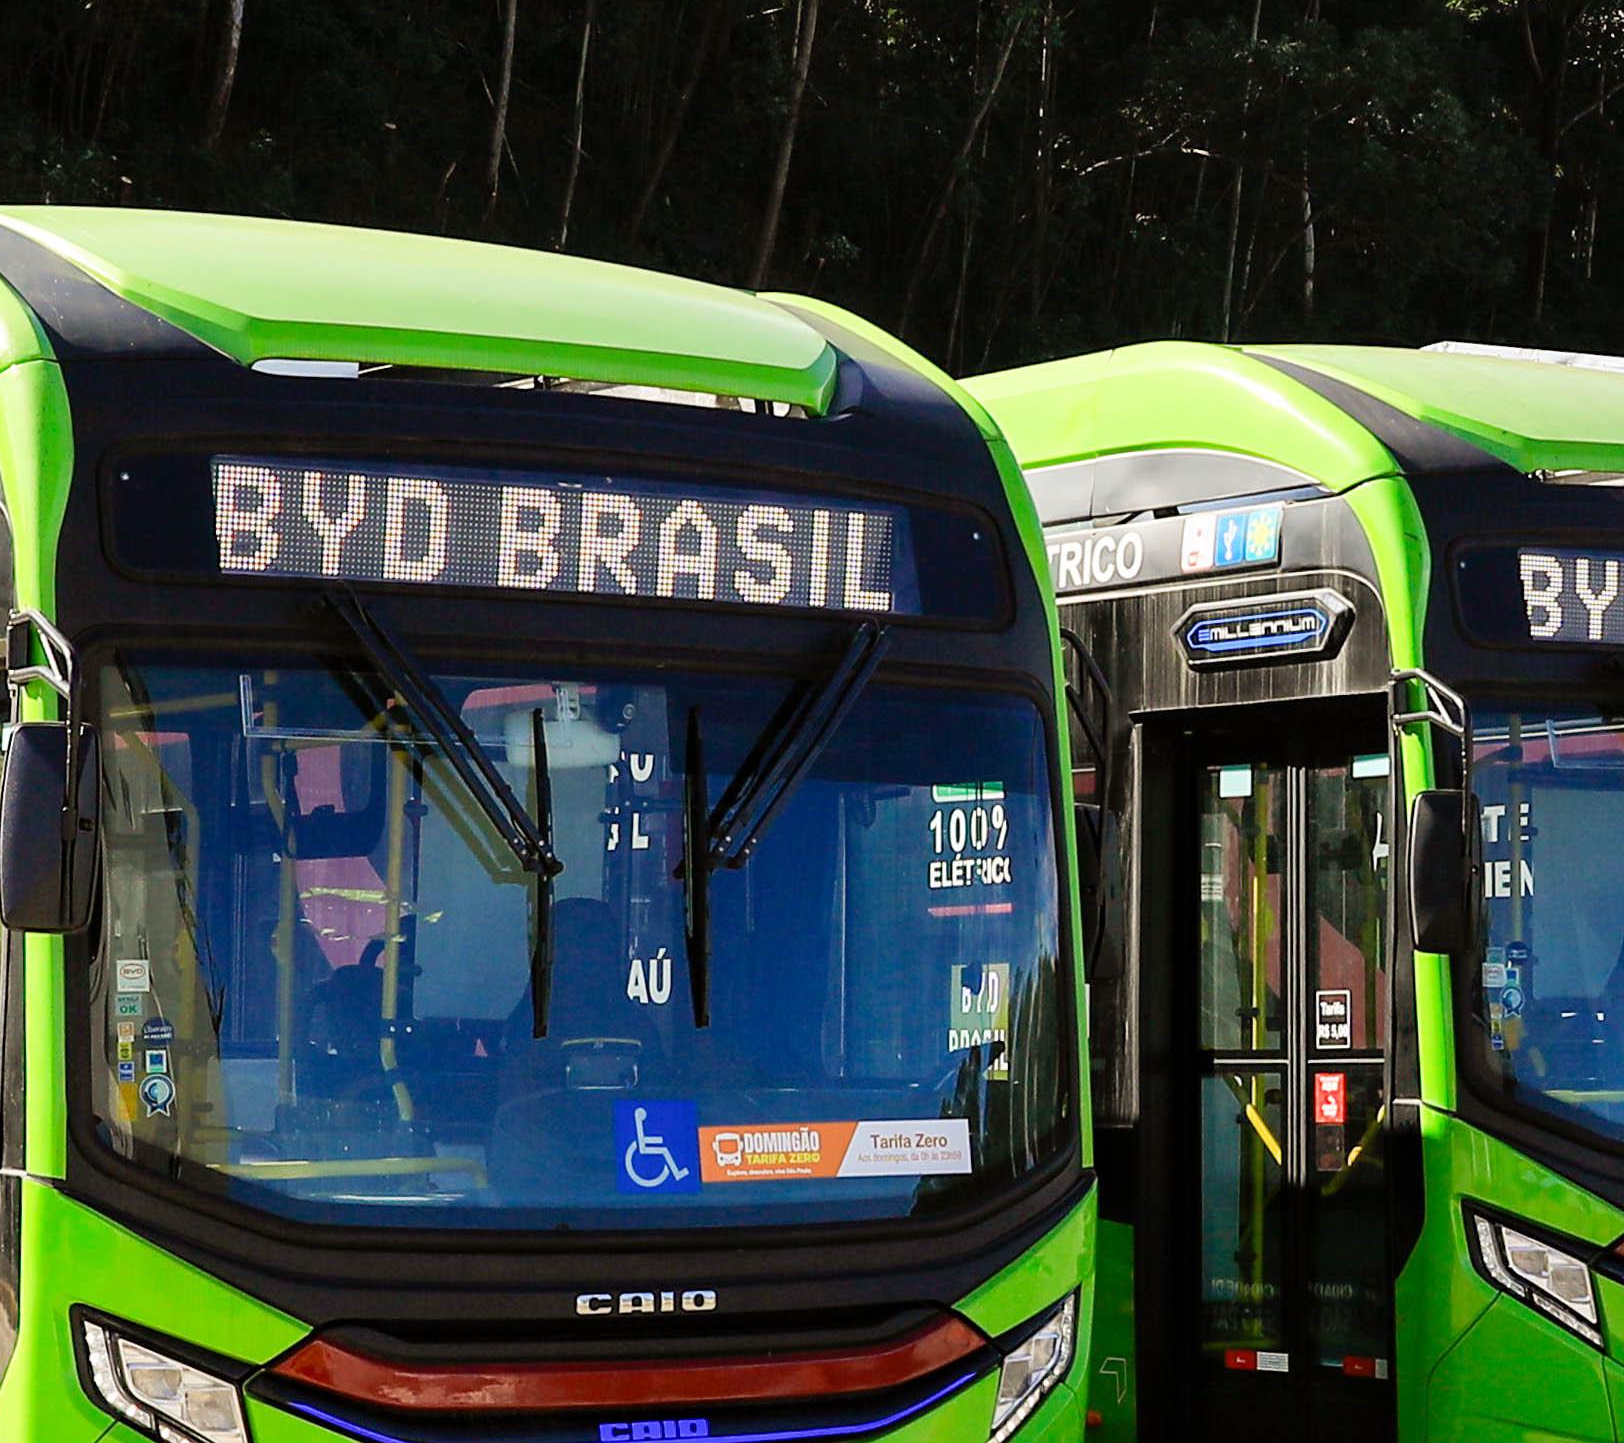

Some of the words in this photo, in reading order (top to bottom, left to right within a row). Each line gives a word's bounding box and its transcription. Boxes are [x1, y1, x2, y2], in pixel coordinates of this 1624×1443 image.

[216, 463, 448, 582] BYD
[495, 485, 892, 612] BRASIL
[1046, 531, 1143, 589] TRICO
[119, 1005, 137, 1014] OK
[744, 1127, 820, 1154] DOMINGÃO
[870, 1133, 911, 1150] Tarifa
[914, 1133, 948, 1148] Zero
[746, 1153, 786, 1165] TARIFA
[789, 1152, 821, 1164] ZERO
[576, 1289, 718, 1316] CAIO
[599, 1418, 709, 1443] CAIO
